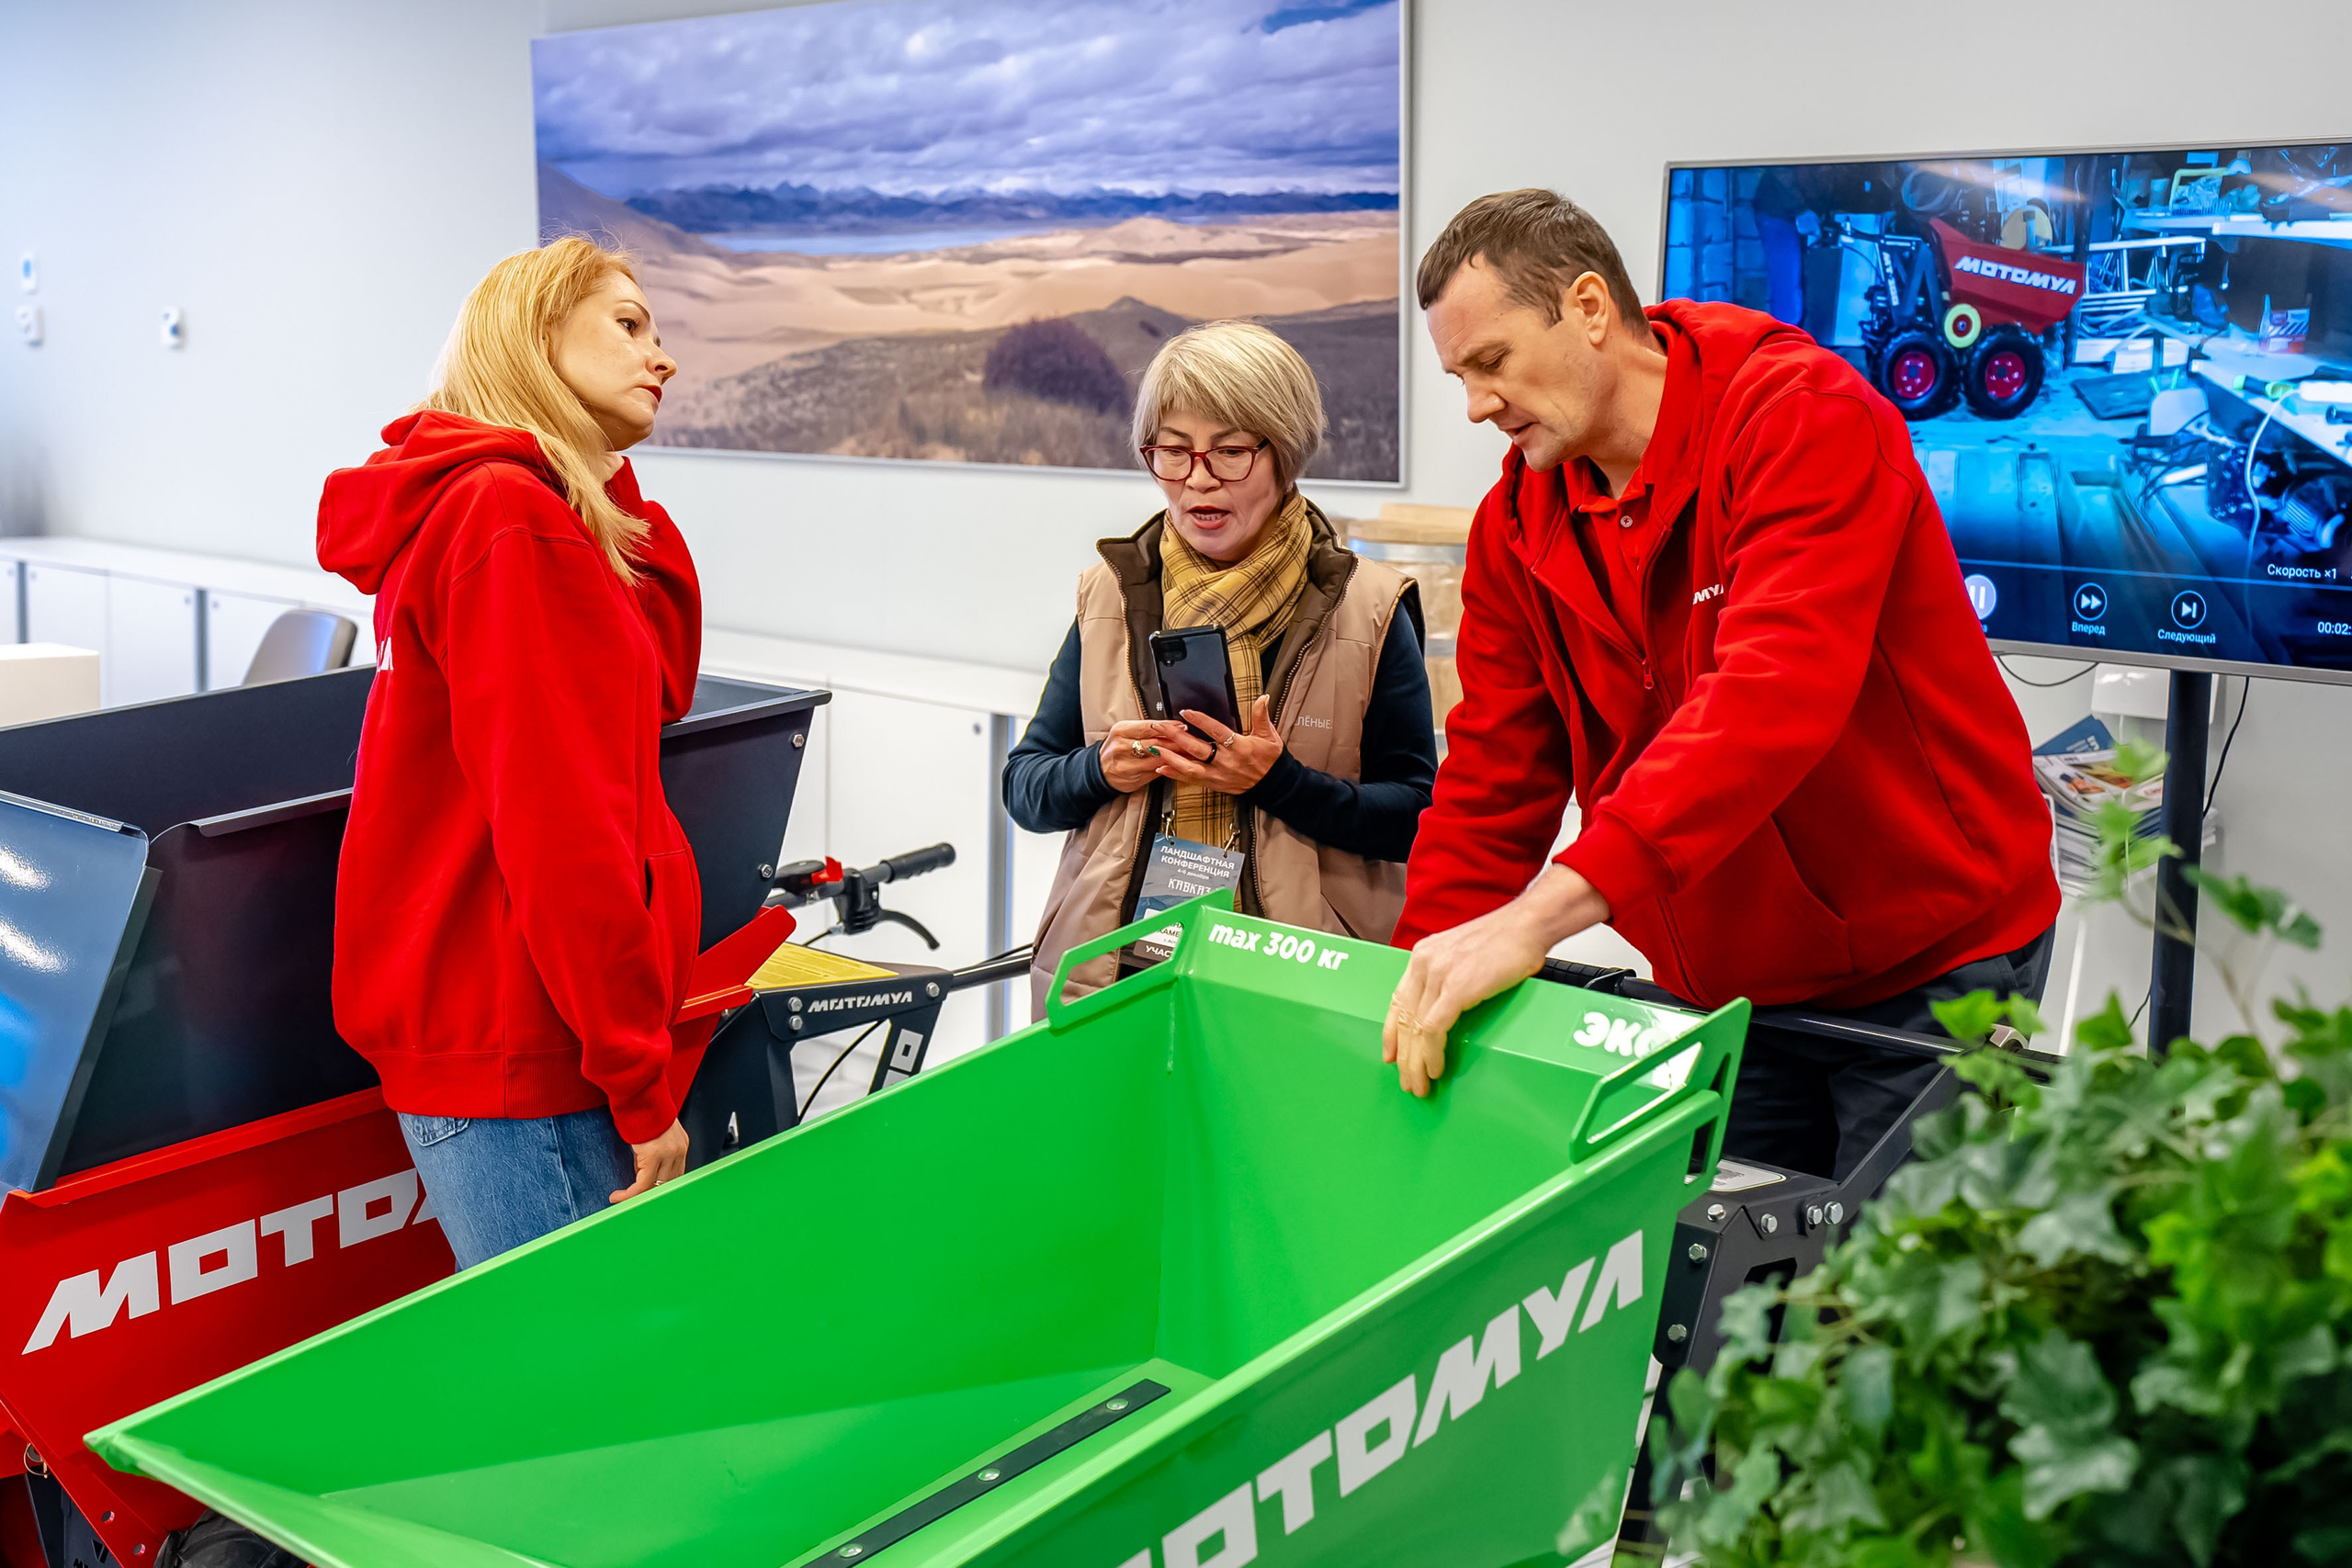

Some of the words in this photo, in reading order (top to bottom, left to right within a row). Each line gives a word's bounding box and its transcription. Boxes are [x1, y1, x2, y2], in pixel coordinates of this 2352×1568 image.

[2267, 563, 2322, 579] Скорость
[2071, 621, 2106, 637] Вперед
[2157, 628, 2216, 644] Следующий
[1159, 845, 1236, 870] ЛАНДШАФТНАЯ
[1159, 854, 1230, 879] КОНФЕРЕНЦИЯ
[1208, 923, 1262, 953] max
[1262, 931, 1316, 964] 300
[1317, 948, 1350, 971] кг
[21, 1168, 437, 1355] МОТО
[1116, 1229, 1643, 1568] ОТОМУЛ
